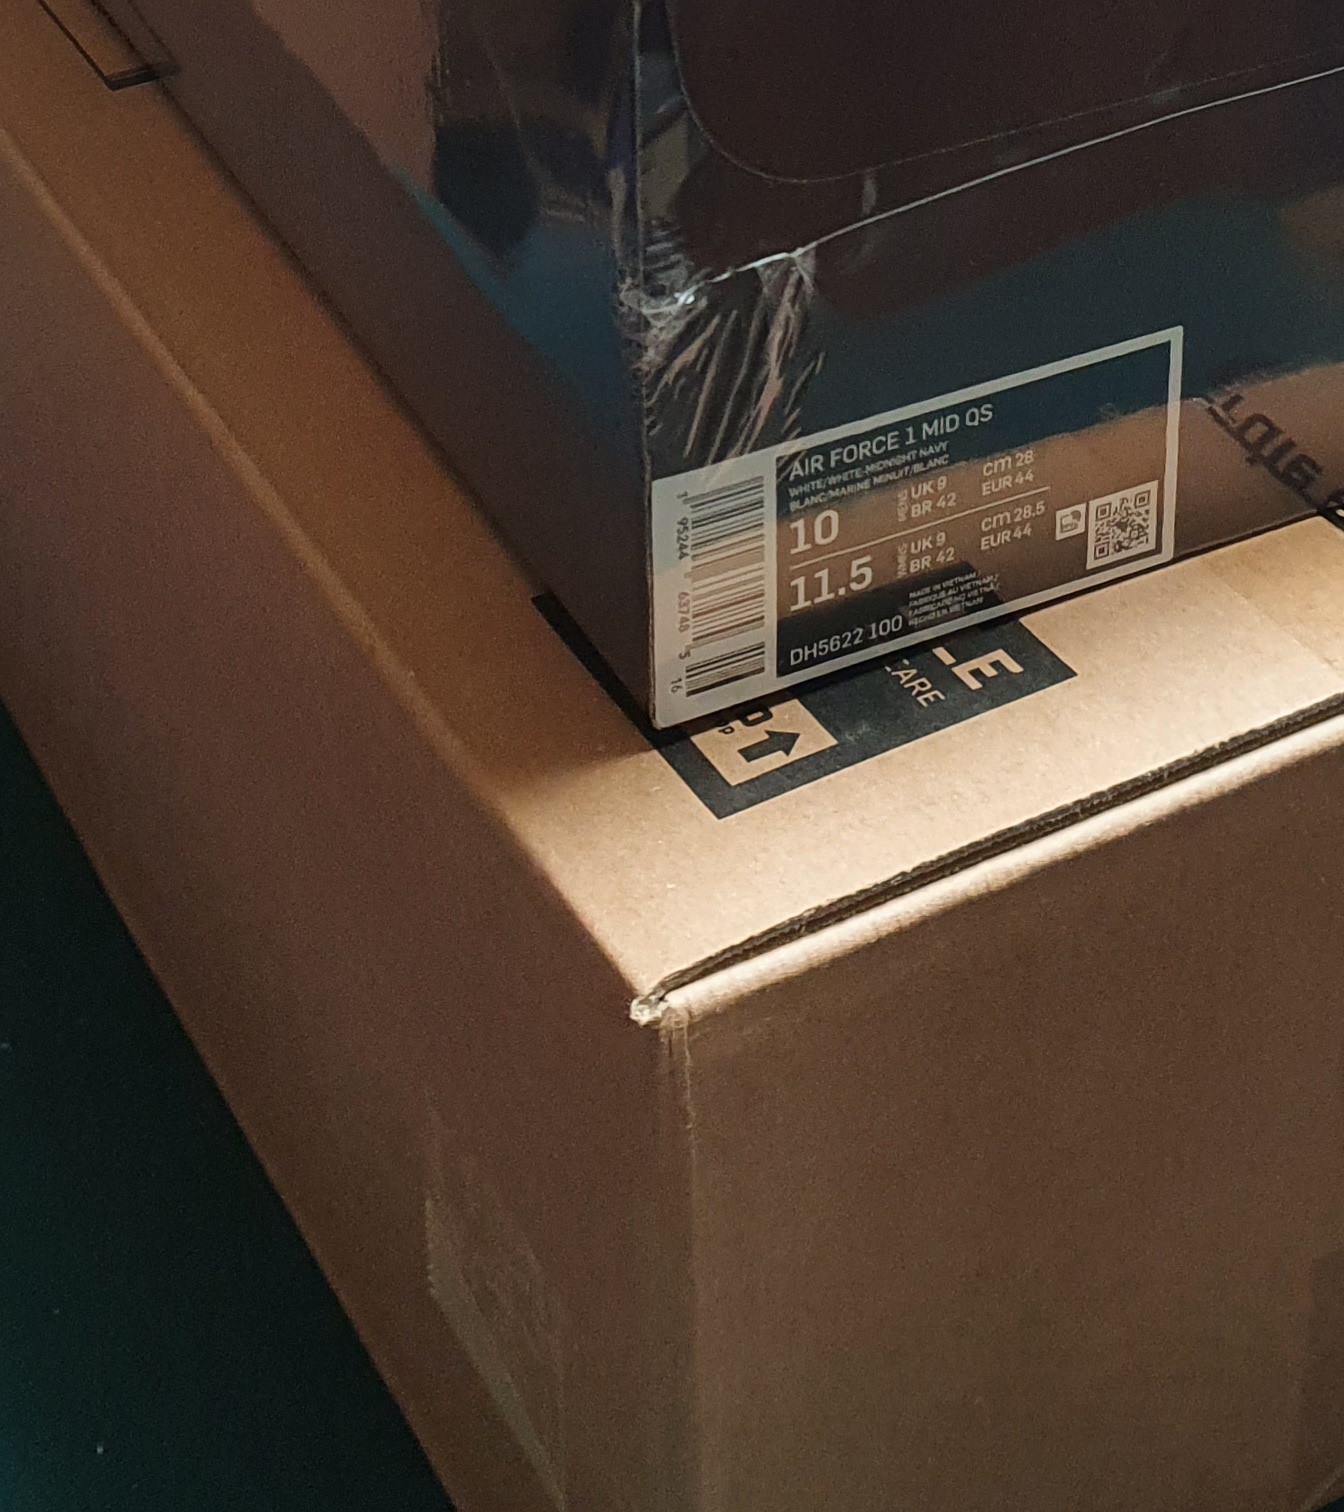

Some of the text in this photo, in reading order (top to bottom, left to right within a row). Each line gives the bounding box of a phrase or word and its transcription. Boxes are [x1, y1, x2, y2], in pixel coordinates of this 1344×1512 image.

[789, 403, 994, 482] AIR FORCE 1 MID QS
[919, 439, 950, 460] NAVY
[982, 450, 1036, 478] cm 28
[910, 475, 948, 500] UK 9
[981, 468, 1036, 496] EUR 44
[910, 492, 958, 519] BR 42
[981, 501, 1047, 533] cm 28.5
[675, 515, 691, 560] 95244
[788, 508, 840, 556] 10
[910, 531, 947, 555] UK 9
[980, 522, 1033, 552] EUR 44
[909, 547, 956, 575] BR 42
[788, 554, 874, 613] 11.5
[675, 590, 691, 635] 63748
[789, 613, 904, 666] DH5622 100
[669, 675, 683, 696] 16
[885, 659, 946, 708] ARE
